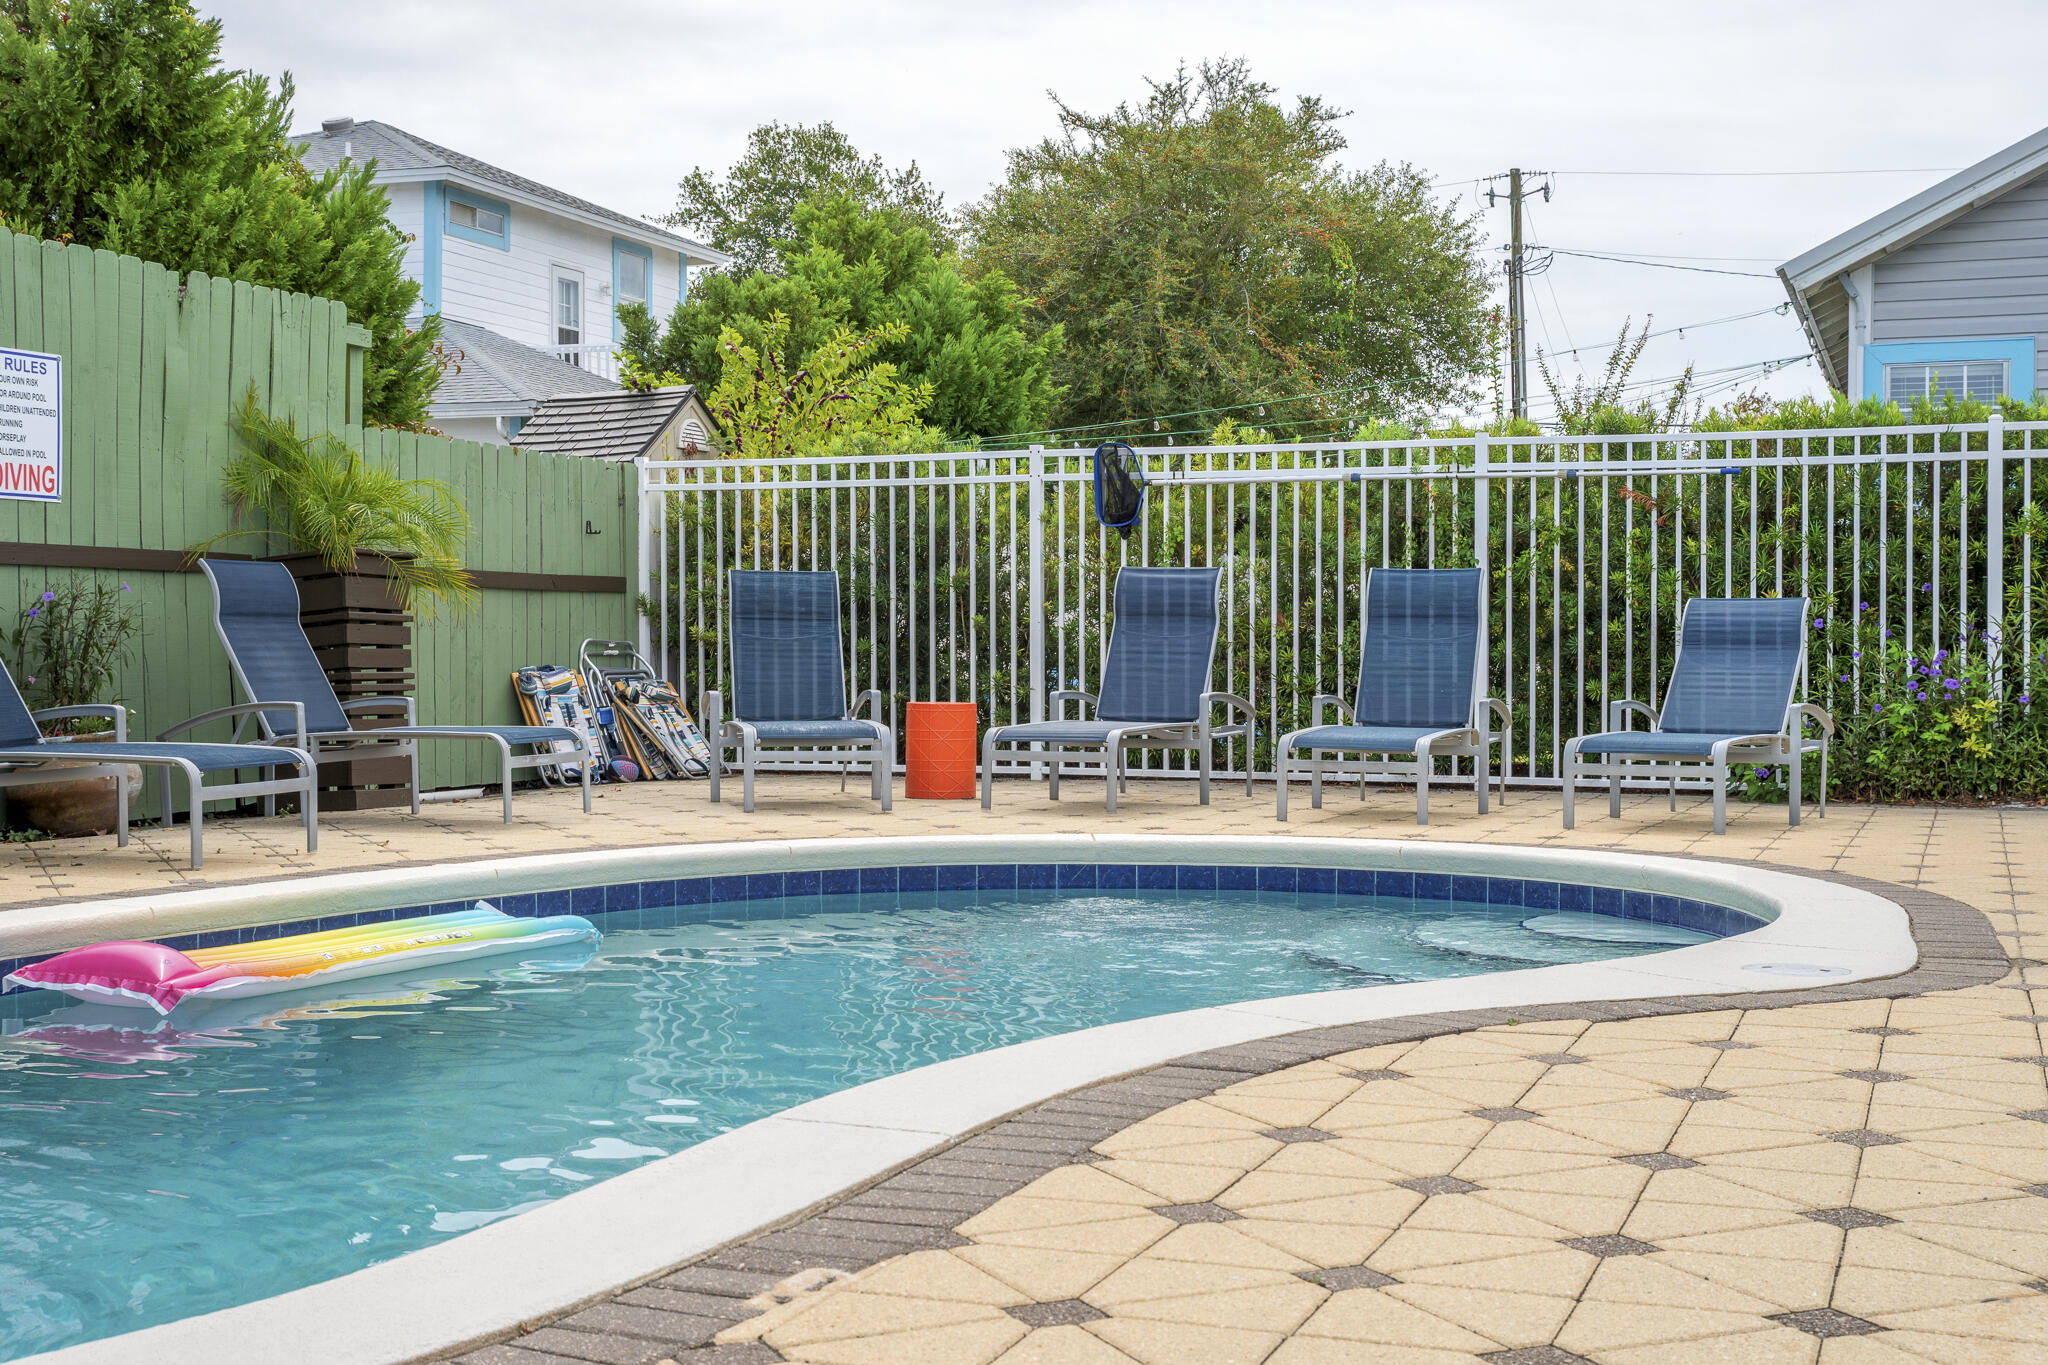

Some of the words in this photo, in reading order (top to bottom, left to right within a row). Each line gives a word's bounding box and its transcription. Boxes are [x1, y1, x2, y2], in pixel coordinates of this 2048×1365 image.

[5, 357, 47, 375] RULES
[12, 376, 25, 385] OWN
[26, 378, 39, 387] RISK
[8, 390, 31, 400] AROUND
[32, 393, 47, 402] POOL
[22, 406, 56, 417] UNATTENDED
[26, 449, 31, 457] IN
[33, 450, 47, 459] POOL
[0, 462, 55, 493] IVING
